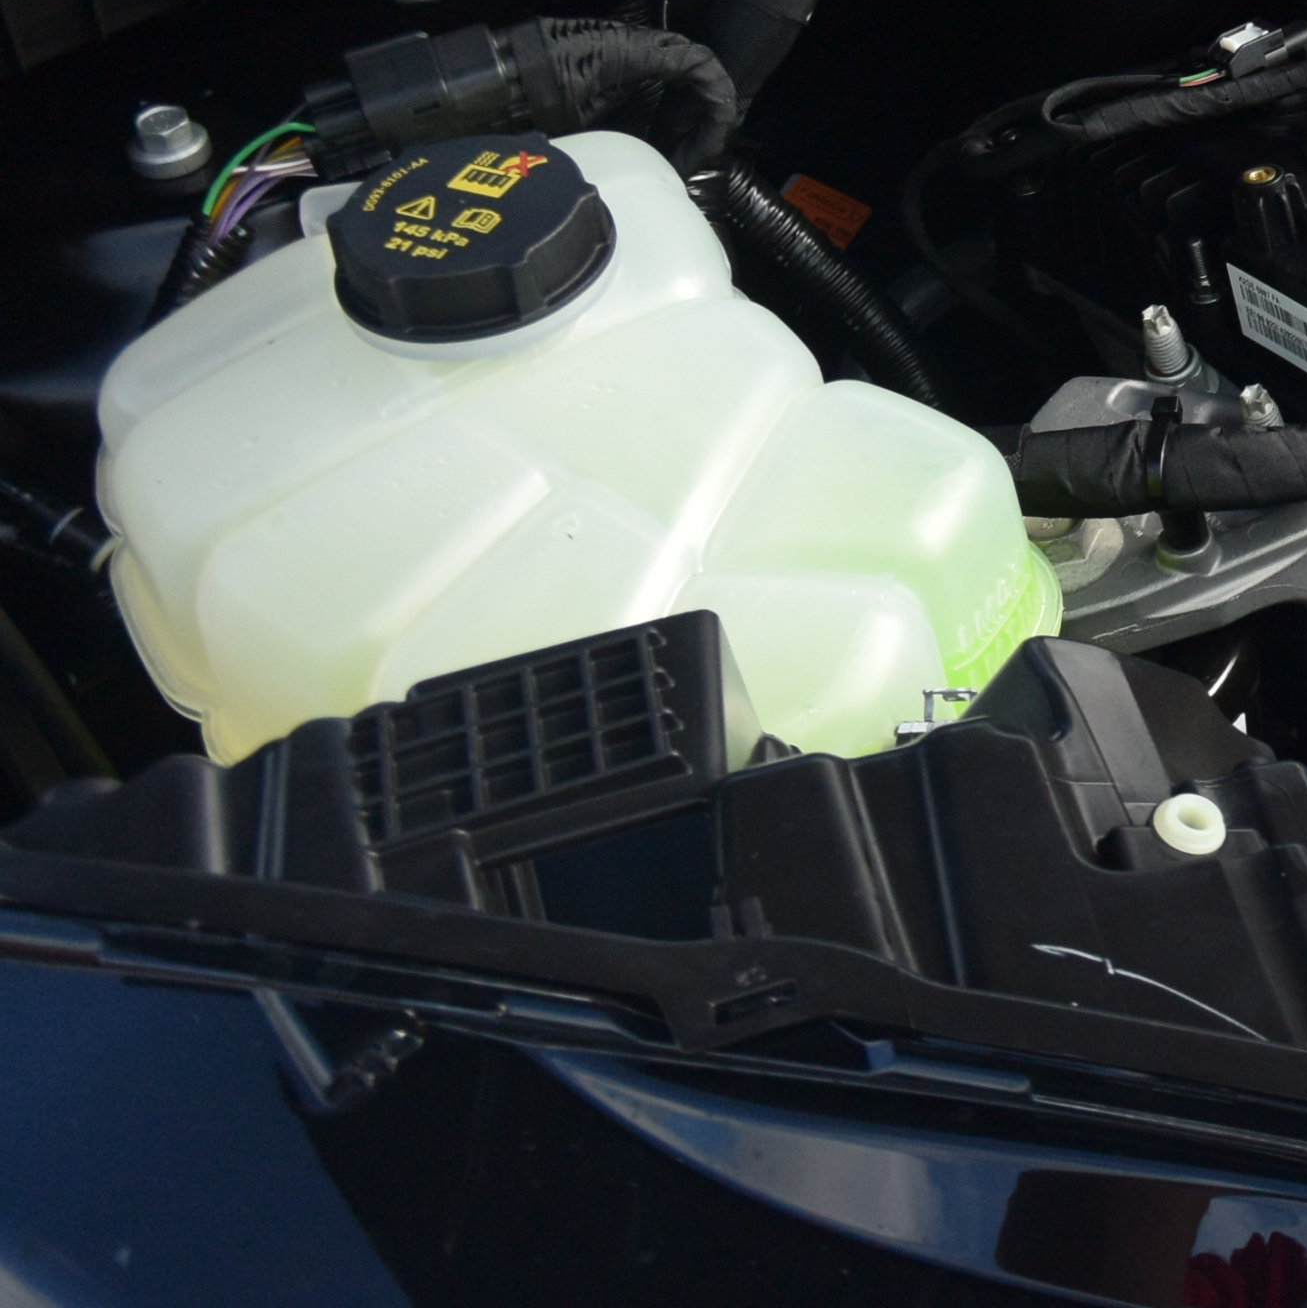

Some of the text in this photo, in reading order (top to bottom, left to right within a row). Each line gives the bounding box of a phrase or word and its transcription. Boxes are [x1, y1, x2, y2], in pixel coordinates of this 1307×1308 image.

[393, 221, 470, 248] 145 kPa
[384, 237, 447, 260] 21 psi
